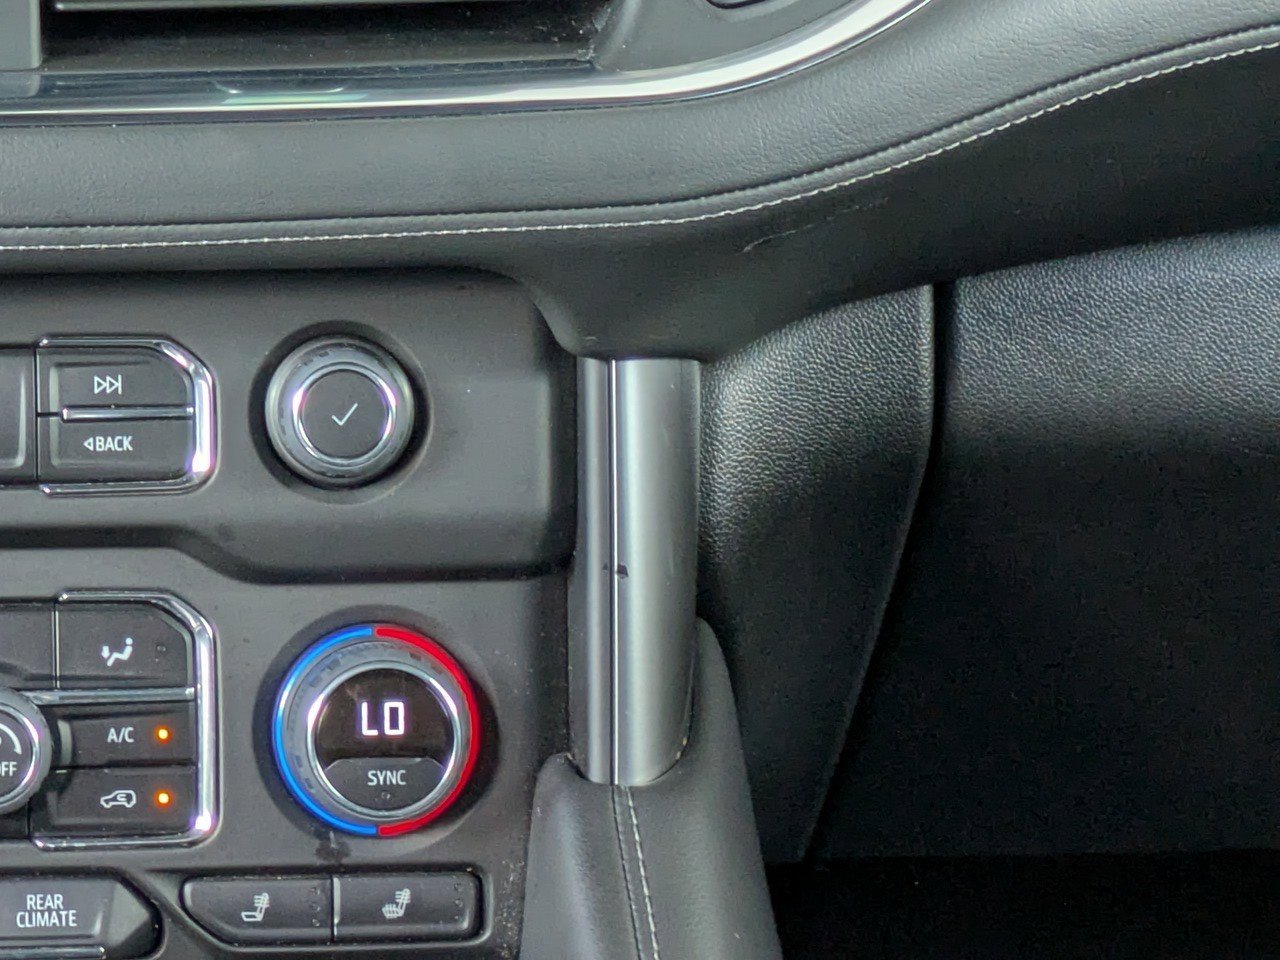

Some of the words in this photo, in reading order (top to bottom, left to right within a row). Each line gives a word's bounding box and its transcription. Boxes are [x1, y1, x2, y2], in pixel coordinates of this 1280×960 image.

[95, 436, 133, 451] BACK
[361, 701, 405, 736] LO
[107, 727, 134, 743] A/C
[368, 769, 407, 786] SYNC
[26, 894, 64, 910] REAR
[16, 910, 77, 928] CLIMATE
